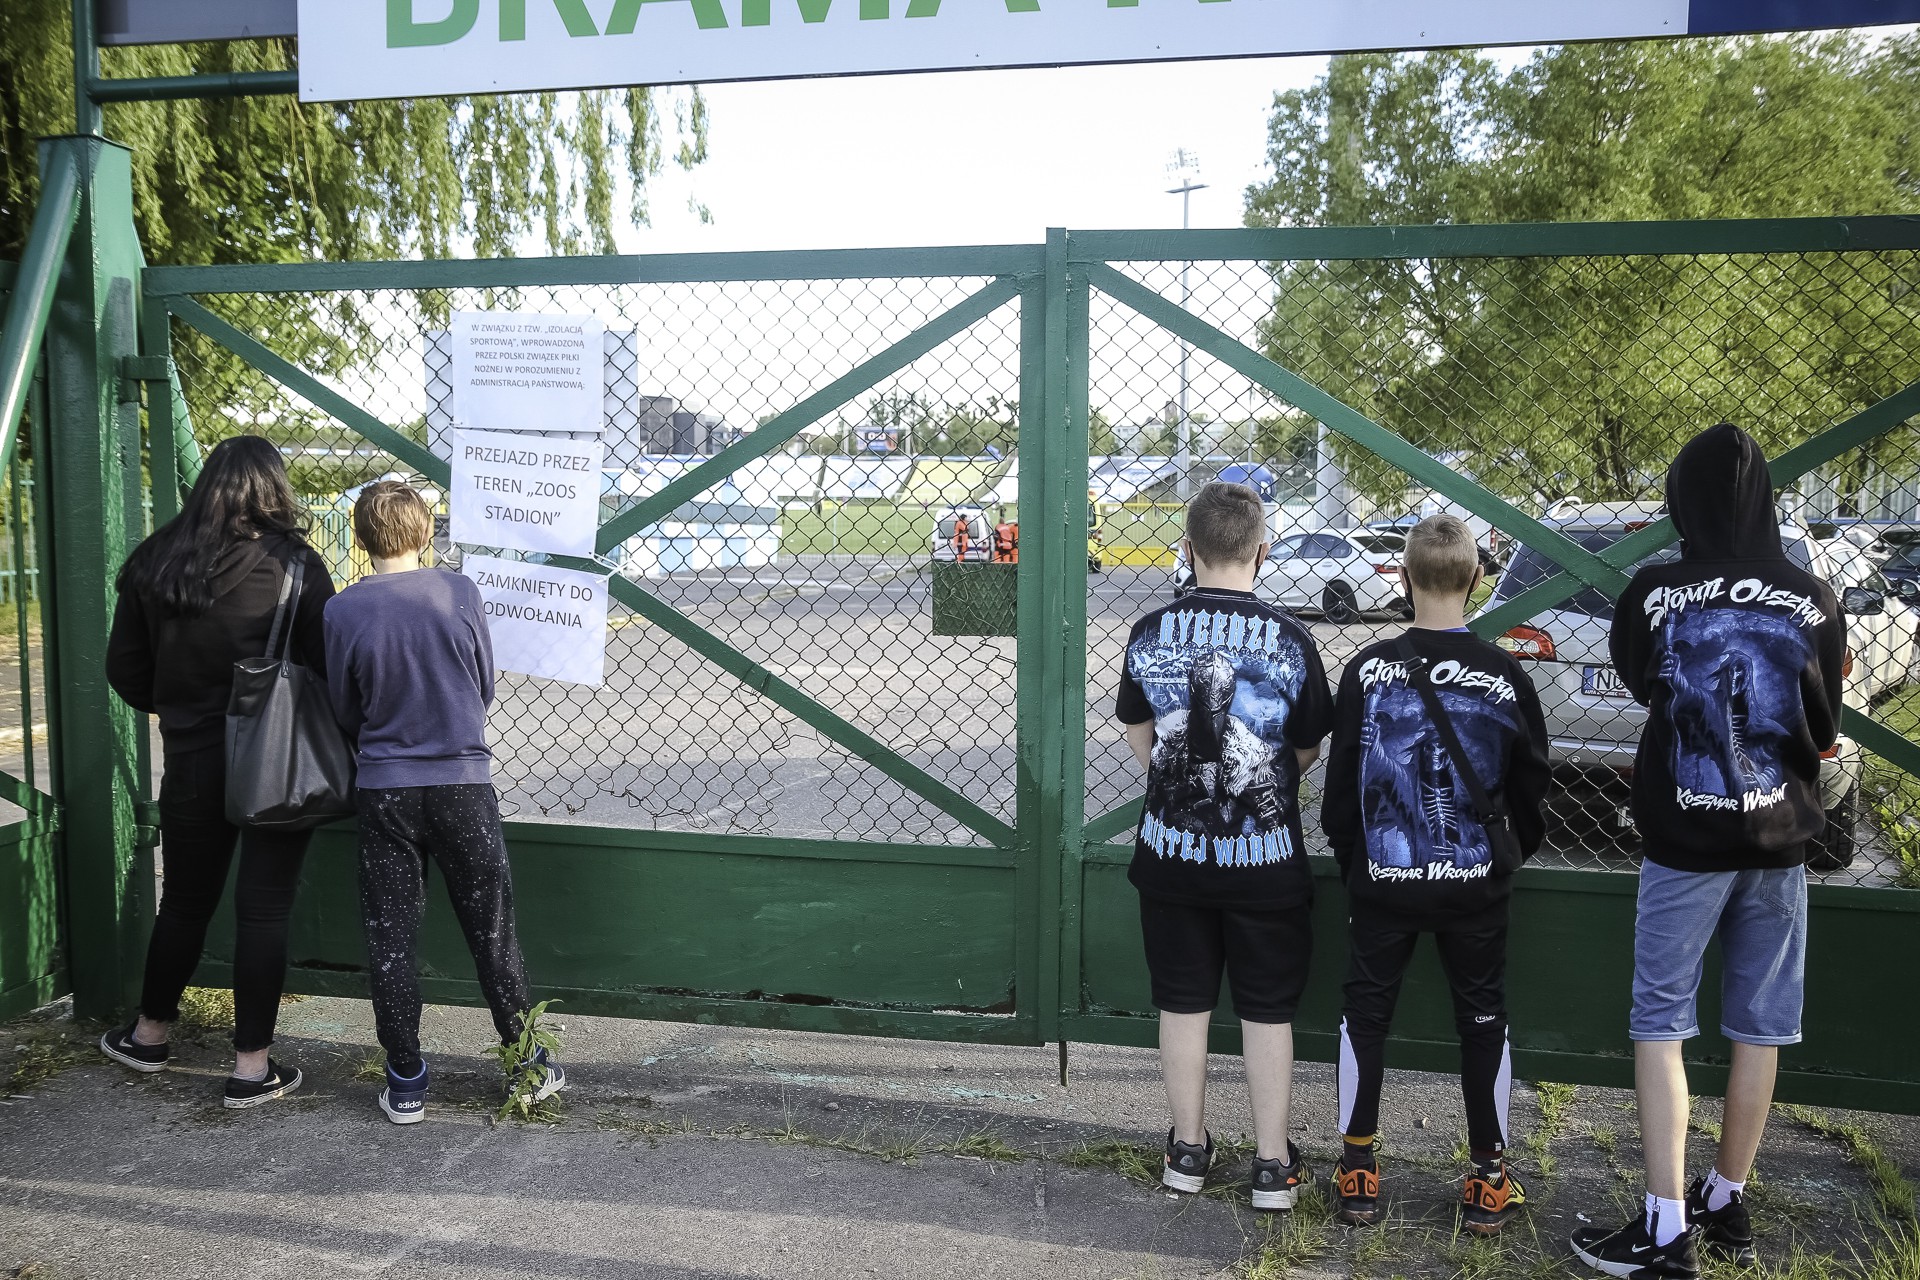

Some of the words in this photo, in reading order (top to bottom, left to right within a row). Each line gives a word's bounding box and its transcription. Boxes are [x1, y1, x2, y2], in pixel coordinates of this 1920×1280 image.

[472, 324, 480, 332] W
[481, 325, 515, 334] ZWIĄZKU
[517, 325, 523, 333] Z
[521, 339, 585, 349] WPROWADZONĄ
[475, 351, 497, 360] PRZEZ
[499, 352, 525, 361] POLSKI
[526, 353, 560, 362] ZWIĄZEK
[561, 353, 580, 361] PIŁKI
[474, 364, 503, 373] NOŻNEJ
[515, 366, 574, 375] POROZUMIENIU
[576, 367, 581, 375] Z
[470, 378, 529, 389] ADMINISTRACJĄ
[464, 445, 539, 466] PRZEJAZD
[543, 454, 591, 472] PRZEZ
[473, 475, 523, 494] TEREN
[484, 505, 561, 526] STADION”
[476, 571, 566, 599] ZAMKNIĘTY
[570, 585, 593, 602] DO
[483, 601, 583, 629] ODWOŁANIA
[1158, 608, 1282, 654] RYCERZE
[1212, 824, 1294, 869] WARMII
[397, 1099, 422, 1110] adidas
